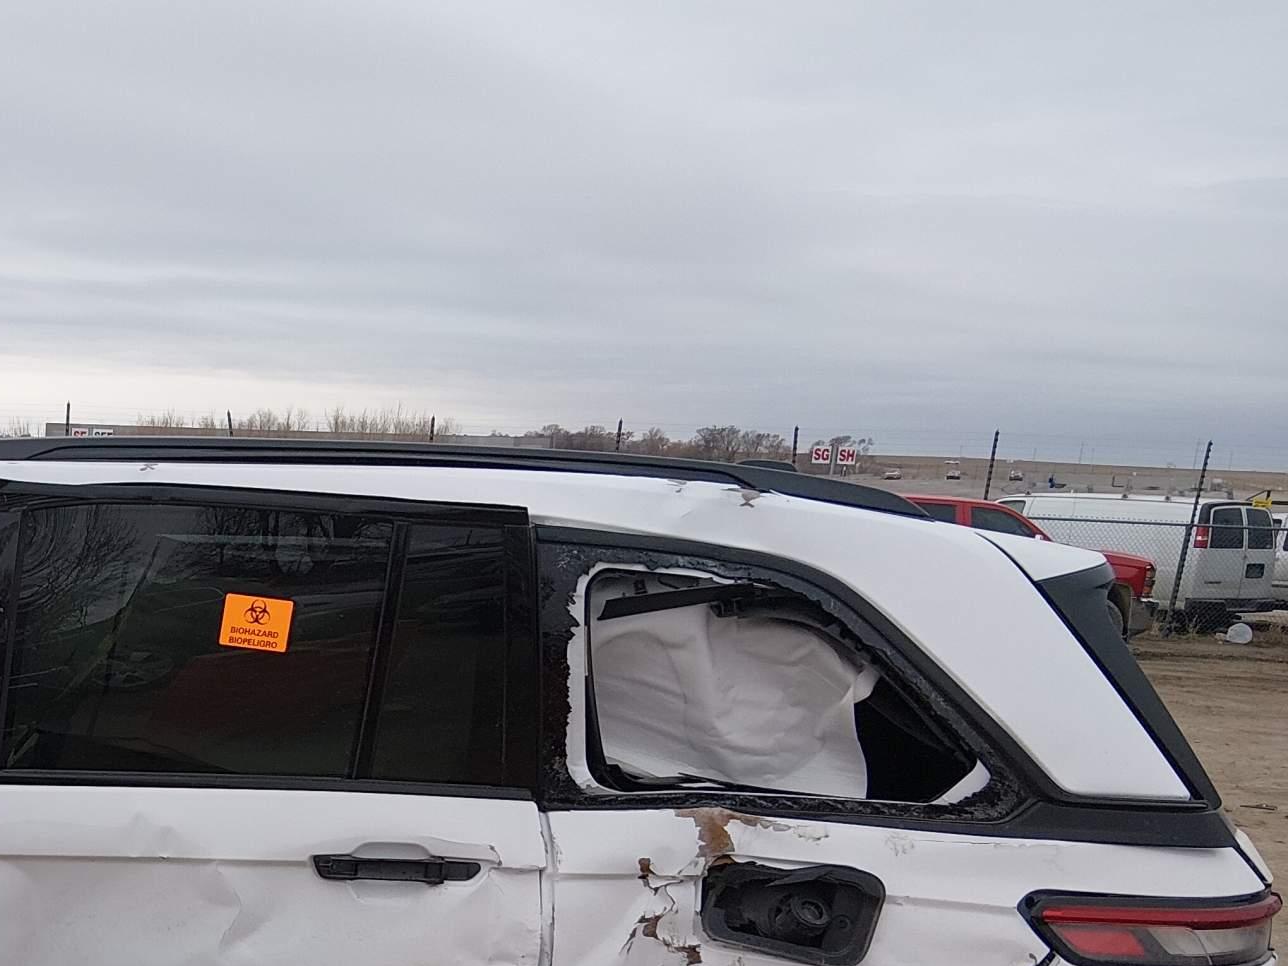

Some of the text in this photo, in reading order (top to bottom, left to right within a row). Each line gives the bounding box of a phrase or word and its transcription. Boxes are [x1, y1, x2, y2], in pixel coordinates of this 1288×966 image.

[813, 448, 830, 461] SG
[838, 449, 856, 462] SH
[230, 626, 279, 639] BIOHAZARD
[228, 636, 278, 649] BIOPELIGRO
